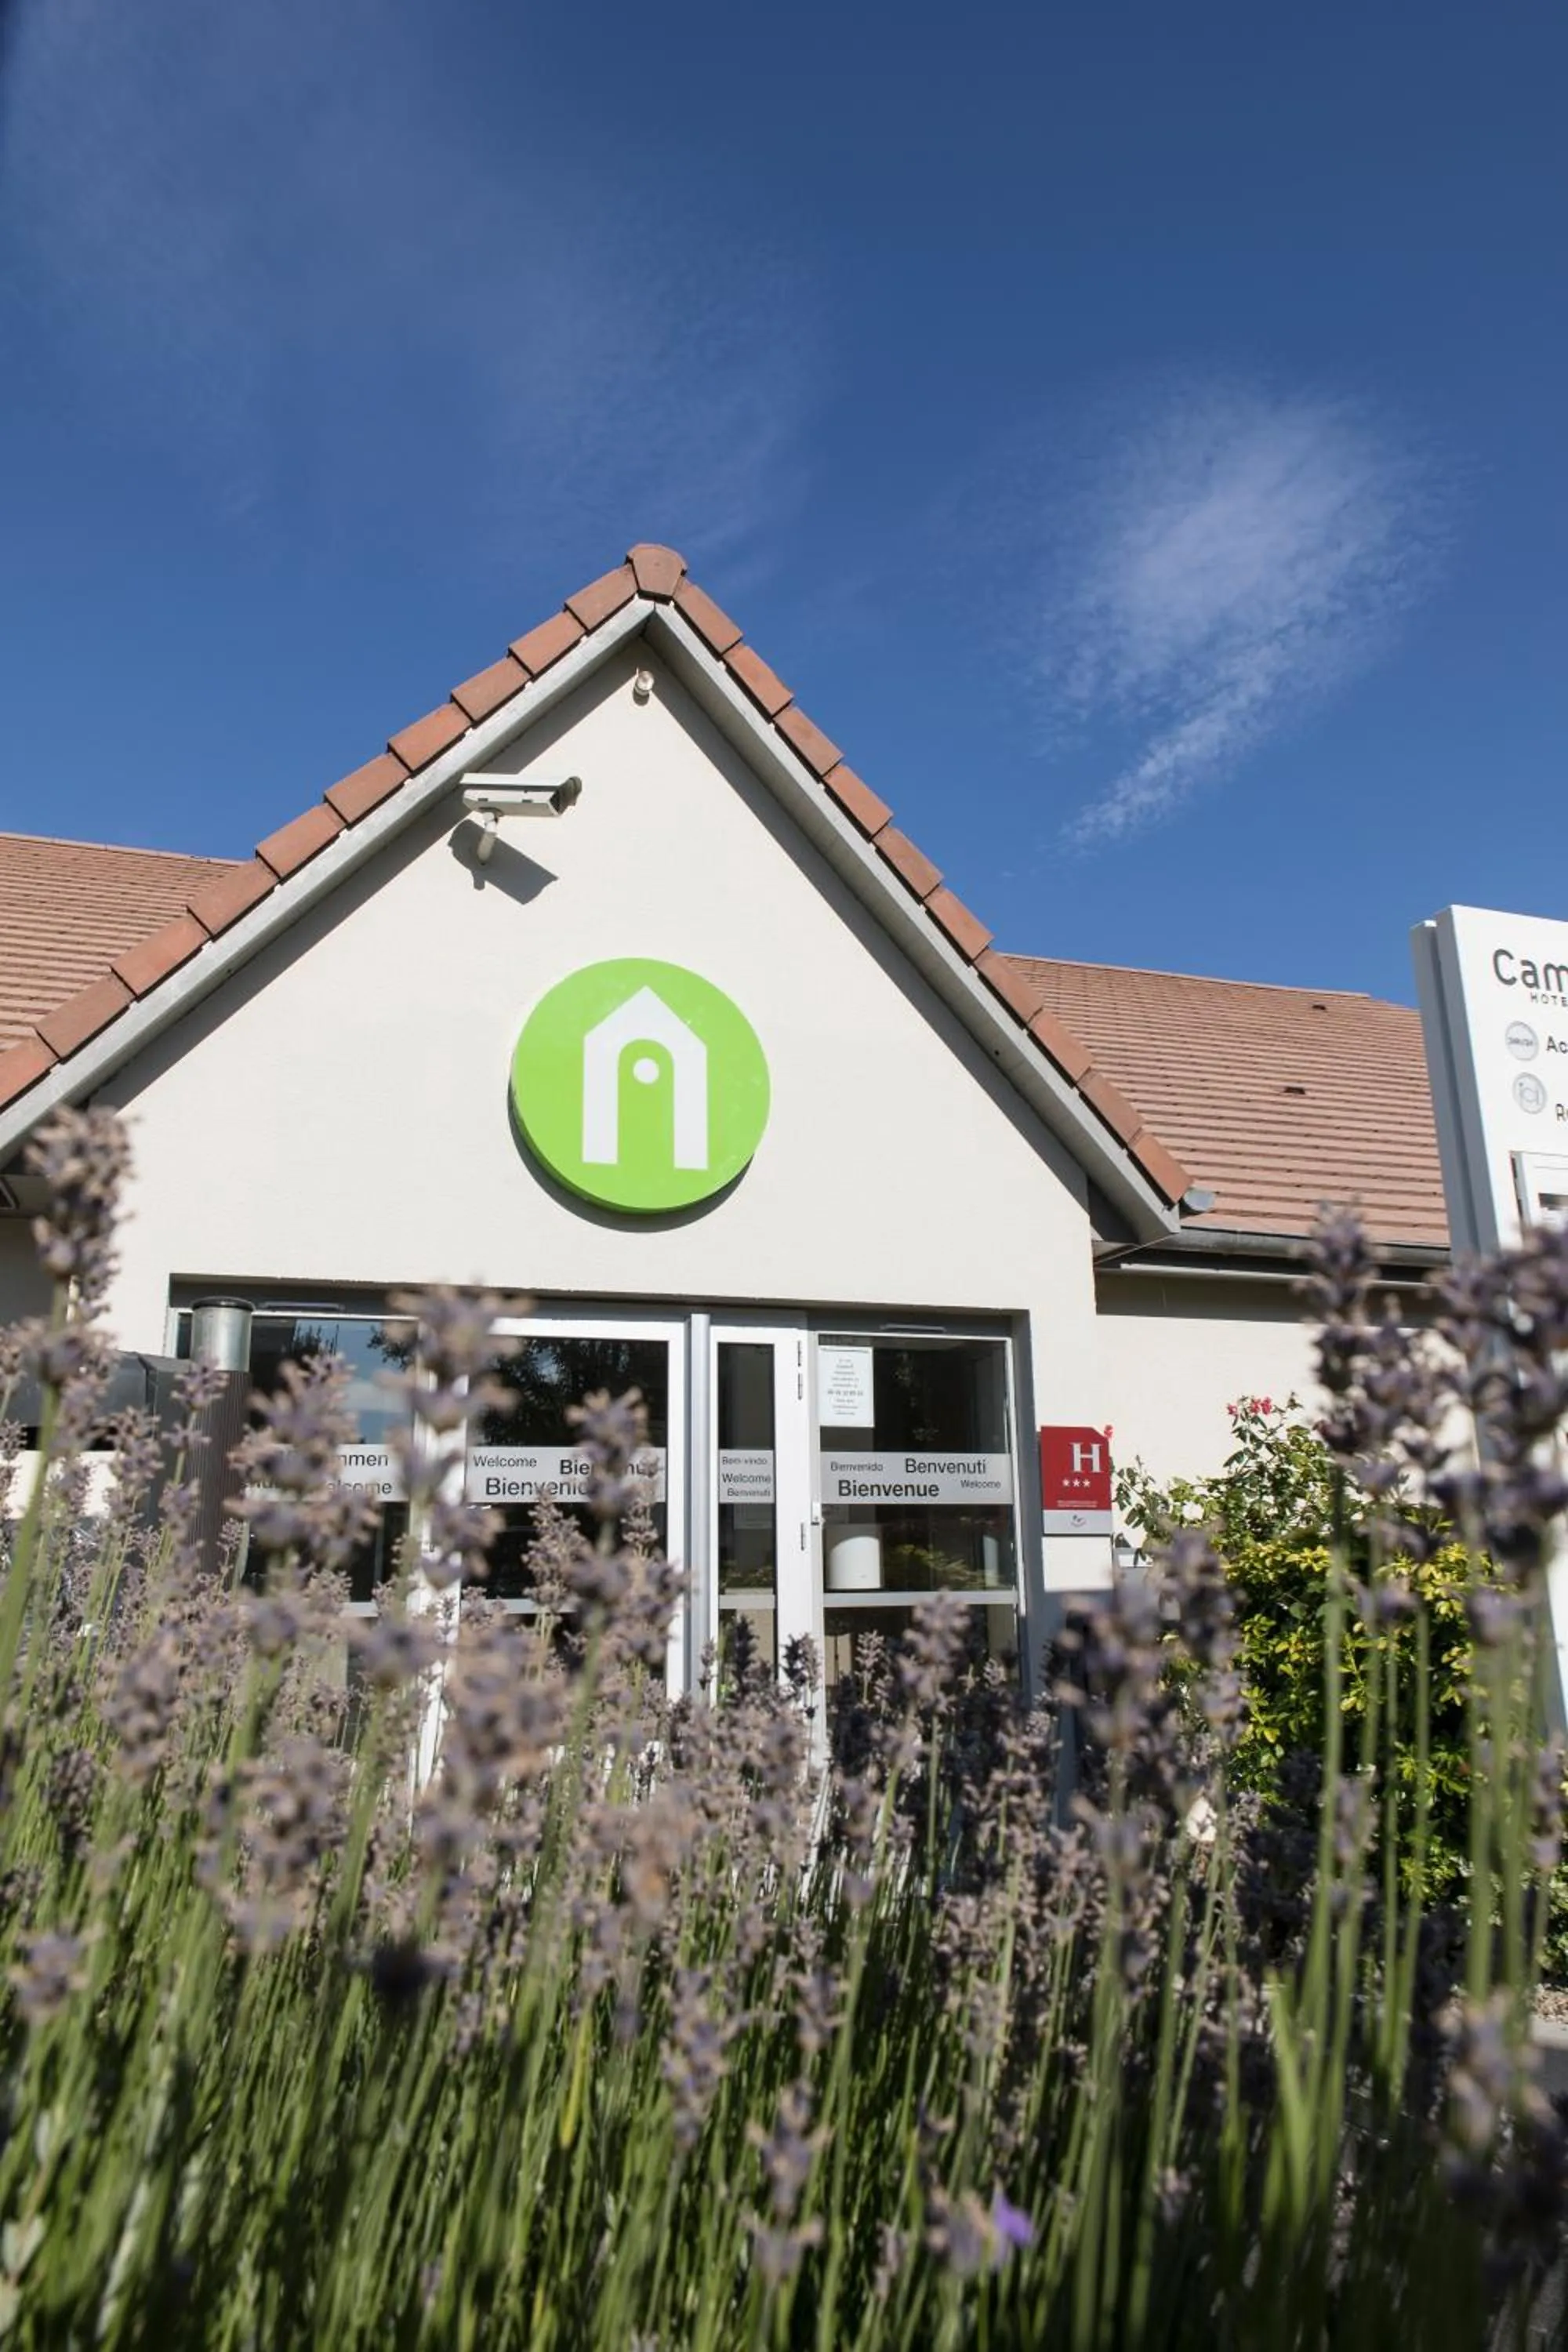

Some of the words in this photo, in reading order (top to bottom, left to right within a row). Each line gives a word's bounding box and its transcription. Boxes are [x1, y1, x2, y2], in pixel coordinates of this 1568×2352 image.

[474, 1455, 537, 1468] Welcome
[1069, 1443, 1104, 1473] H
[830, 1461, 884, 1472] Bienvenido
[905, 1457, 986, 1475] Benvenuti
[722, 1473, 771, 1483] Welcome
[960, 1479, 1001, 1489] Welcome
[327, 1479, 393, 1494] elcome
[838, 1479, 940, 1497] Bienvenue
